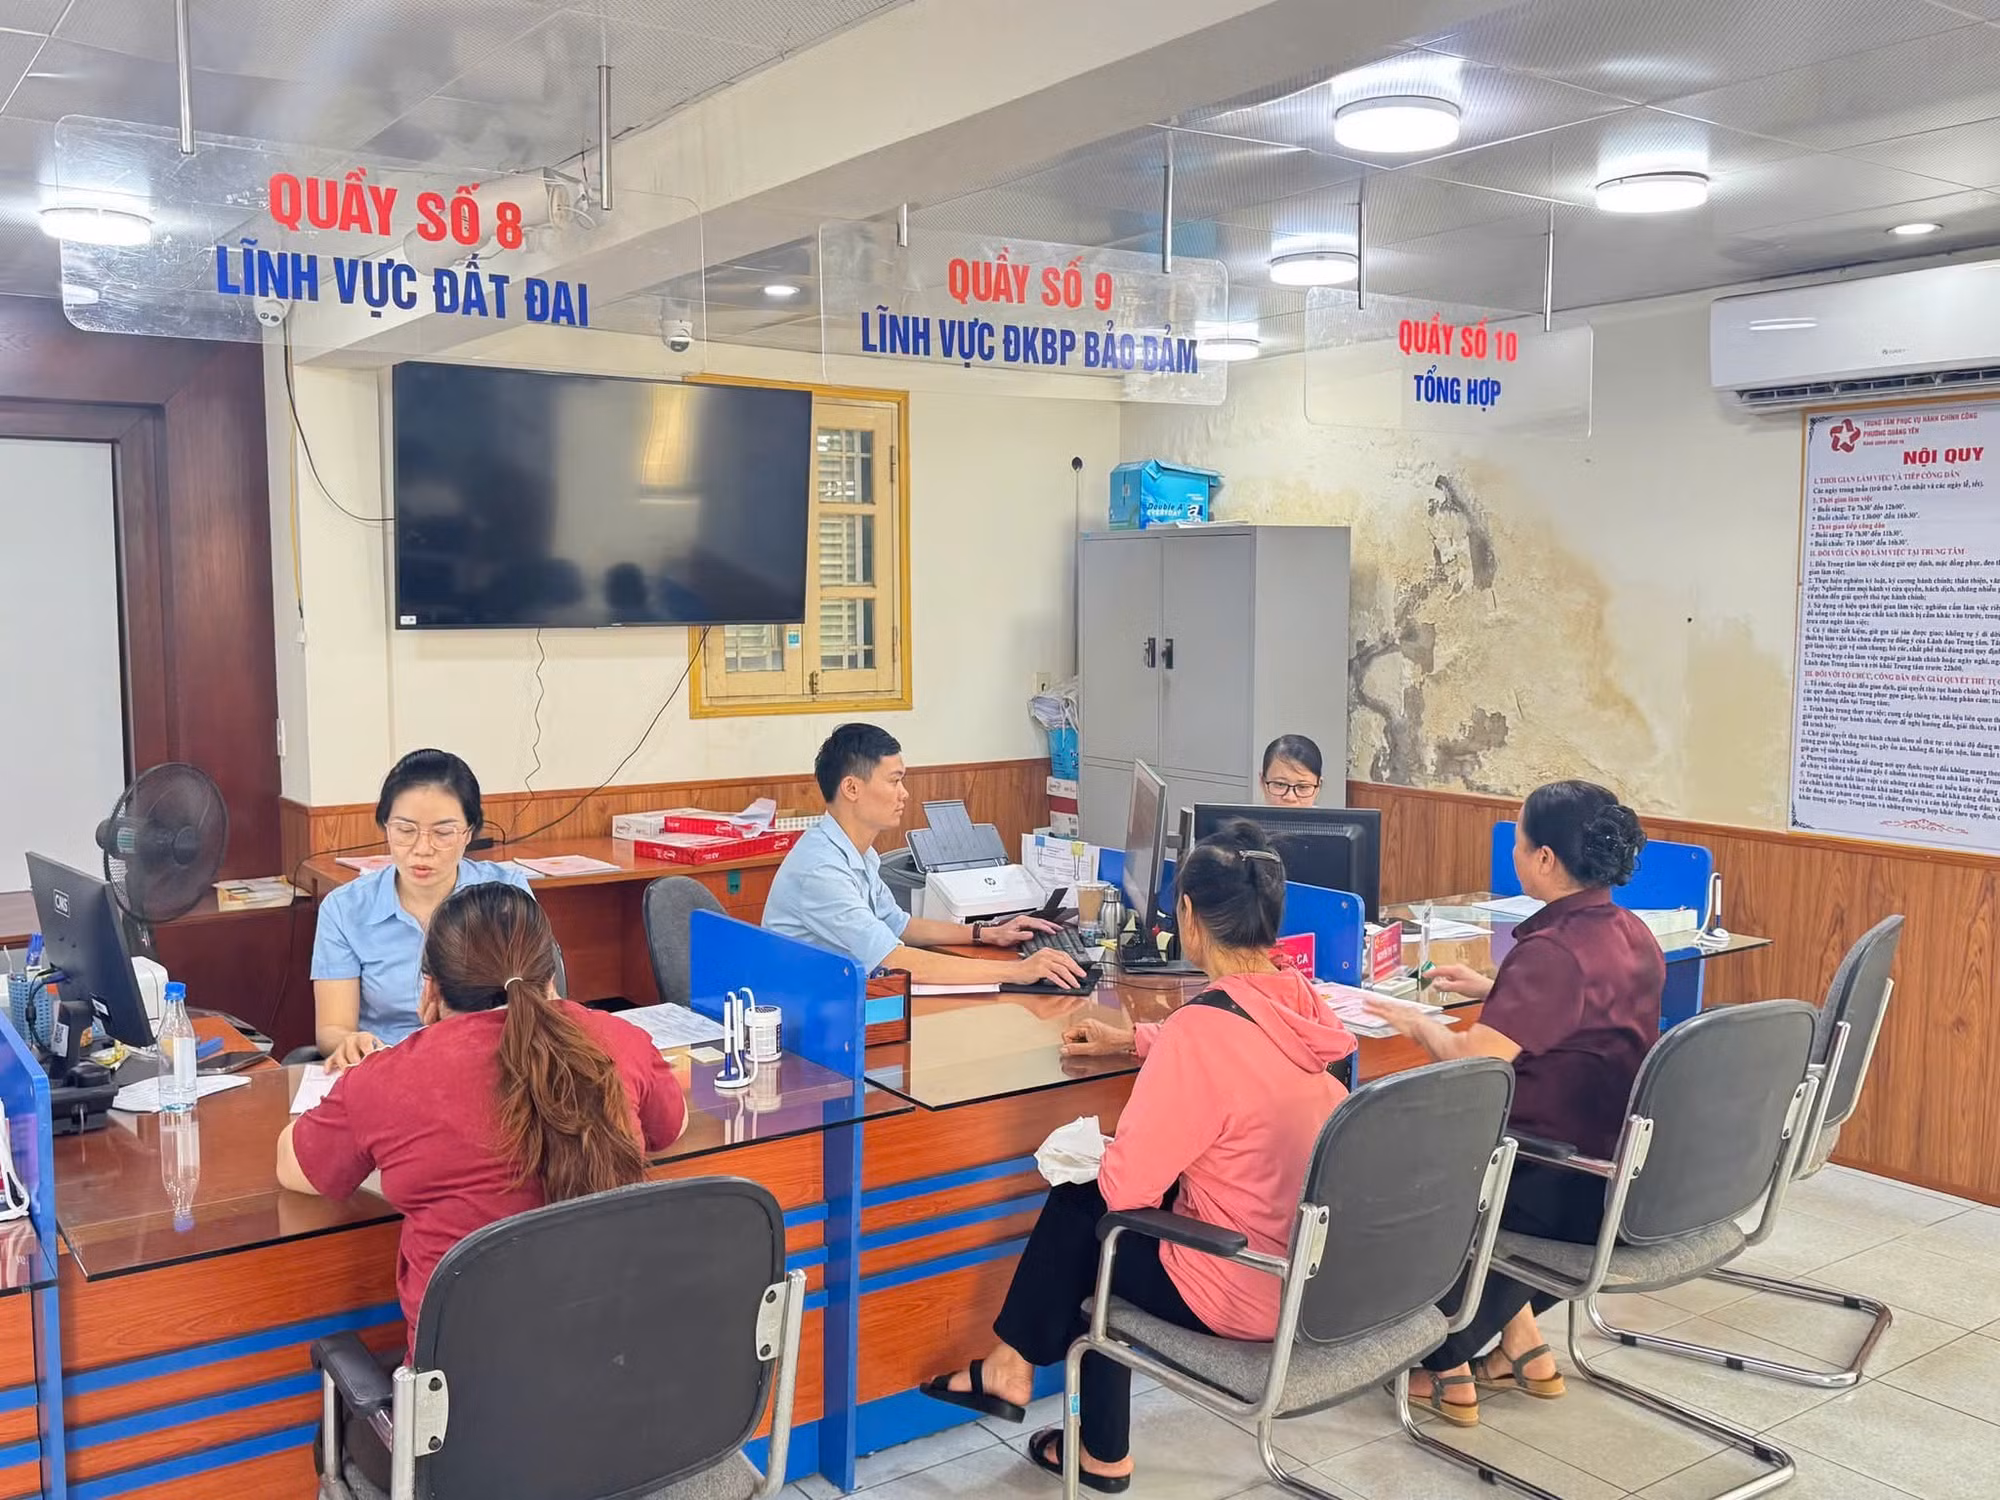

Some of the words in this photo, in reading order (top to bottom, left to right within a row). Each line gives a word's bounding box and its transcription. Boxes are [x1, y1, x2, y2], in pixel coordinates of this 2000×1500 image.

[268, 167, 398, 236] QUẦY
[416, 182, 481, 245] SỐ
[496, 201, 523, 249] 8
[216, 237, 319, 301] LĨNH
[333, 258, 417, 318] VỰC
[432, 253, 510, 319] ĐẤT
[524, 277, 589, 326] ĐAI
[948, 246, 1030, 305] QUẦY
[1042, 255, 1083, 309] SỐ
[1094, 272, 1113, 311] 9
[861, 304, 931, 356] LĨNH
[938, 318, 995, 369] VỰC
[1003, 325, 1076, 367] ĐKBP
[1084, 319, 1135, 370] BẢO
[1399, 312, 1455, 355] QUẦY
[1461, 316, 1489, 359] SỐ
[1494, 330, 1517, 362] 10
[1413, 364, 1461, 404] TỔNG
[1467, 377, 1502, 412] HỢP
[1903, 447, 1937, 467] NỘI
[1944, 447, 1984, 464] QUY
[1147, 502, 1176, 510] Double
